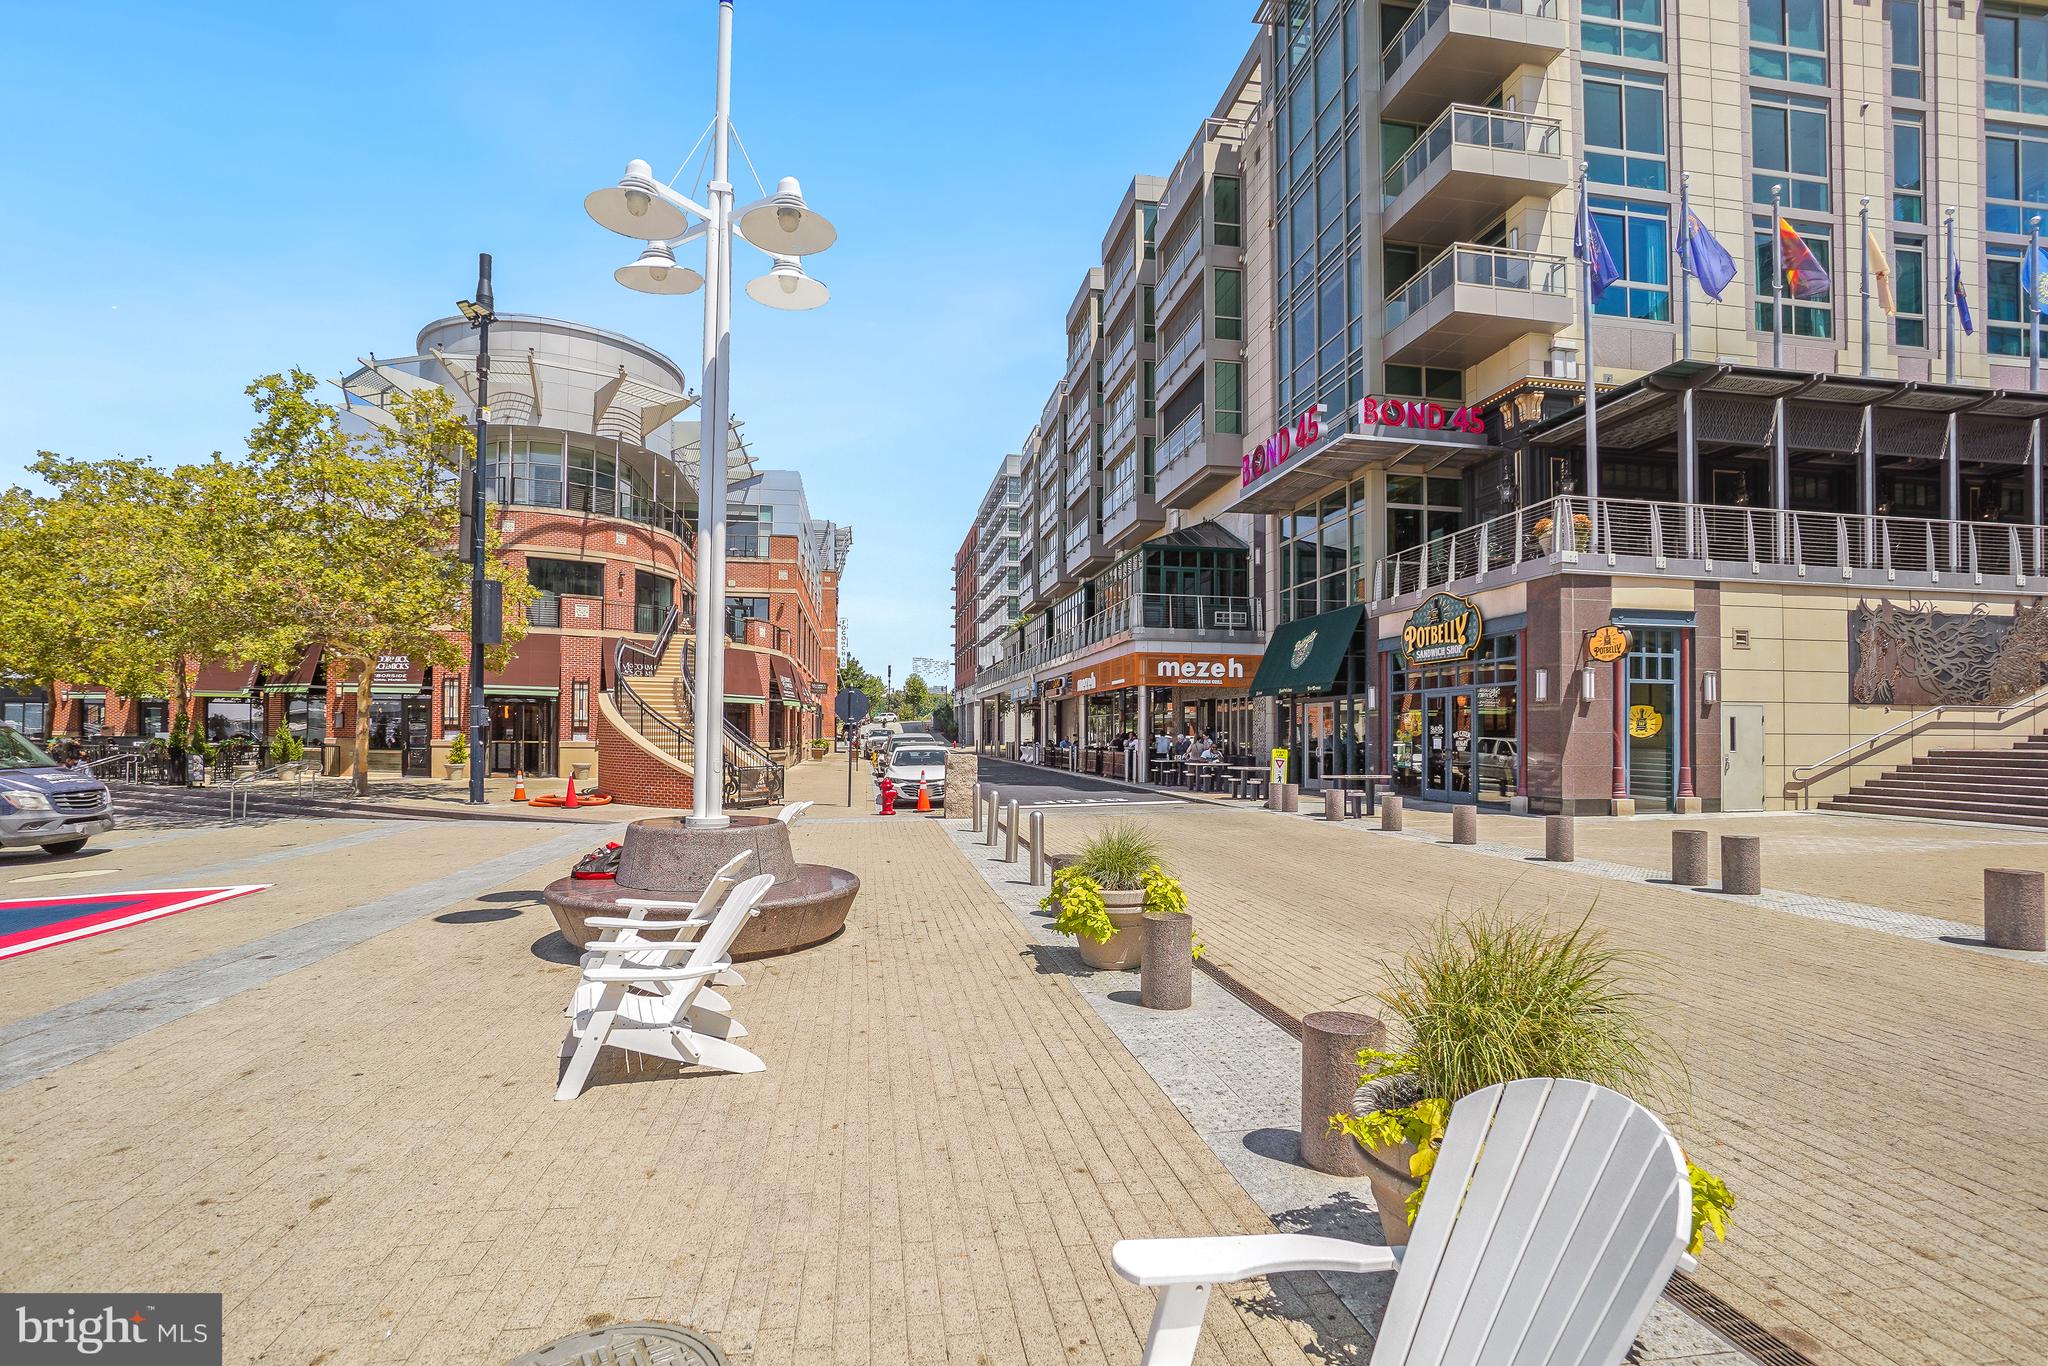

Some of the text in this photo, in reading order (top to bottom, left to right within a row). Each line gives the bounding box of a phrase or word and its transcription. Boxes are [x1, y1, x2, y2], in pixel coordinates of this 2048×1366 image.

[1362, 397, 1485, 434] BOND 45
[1241, 403, 1323, 488] BOND 45
[1404, 610, 1470, 654] POTBELLY
[1416, 645, 1463, 659] SANDWICH SHOP
[1593, 643, 1622, 656] POTBELLY
[1157, 657, 1244, 678] mezeh
